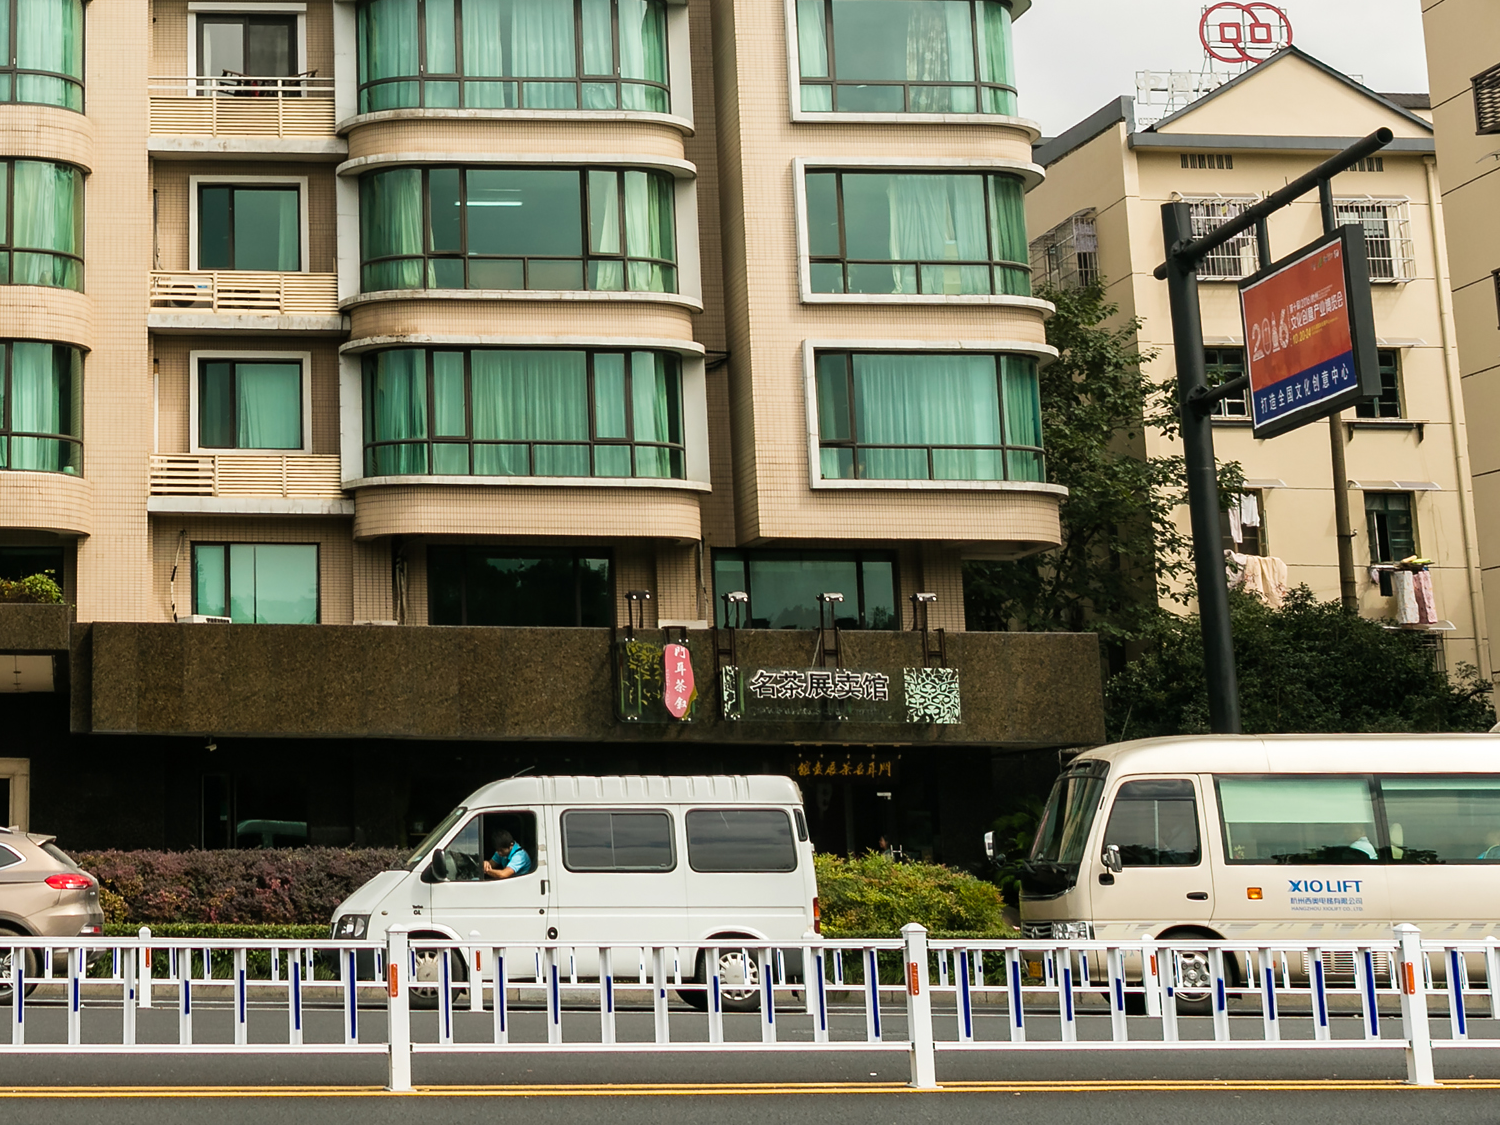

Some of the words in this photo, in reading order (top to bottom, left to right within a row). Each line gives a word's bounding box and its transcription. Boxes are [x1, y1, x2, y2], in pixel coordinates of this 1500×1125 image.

[1252, 309, 1289, 361] 2016
[1260, 363, 1349, 414] 打造全国文化创意中心
[750, 670, 889, 701] 名茶展卖馆
